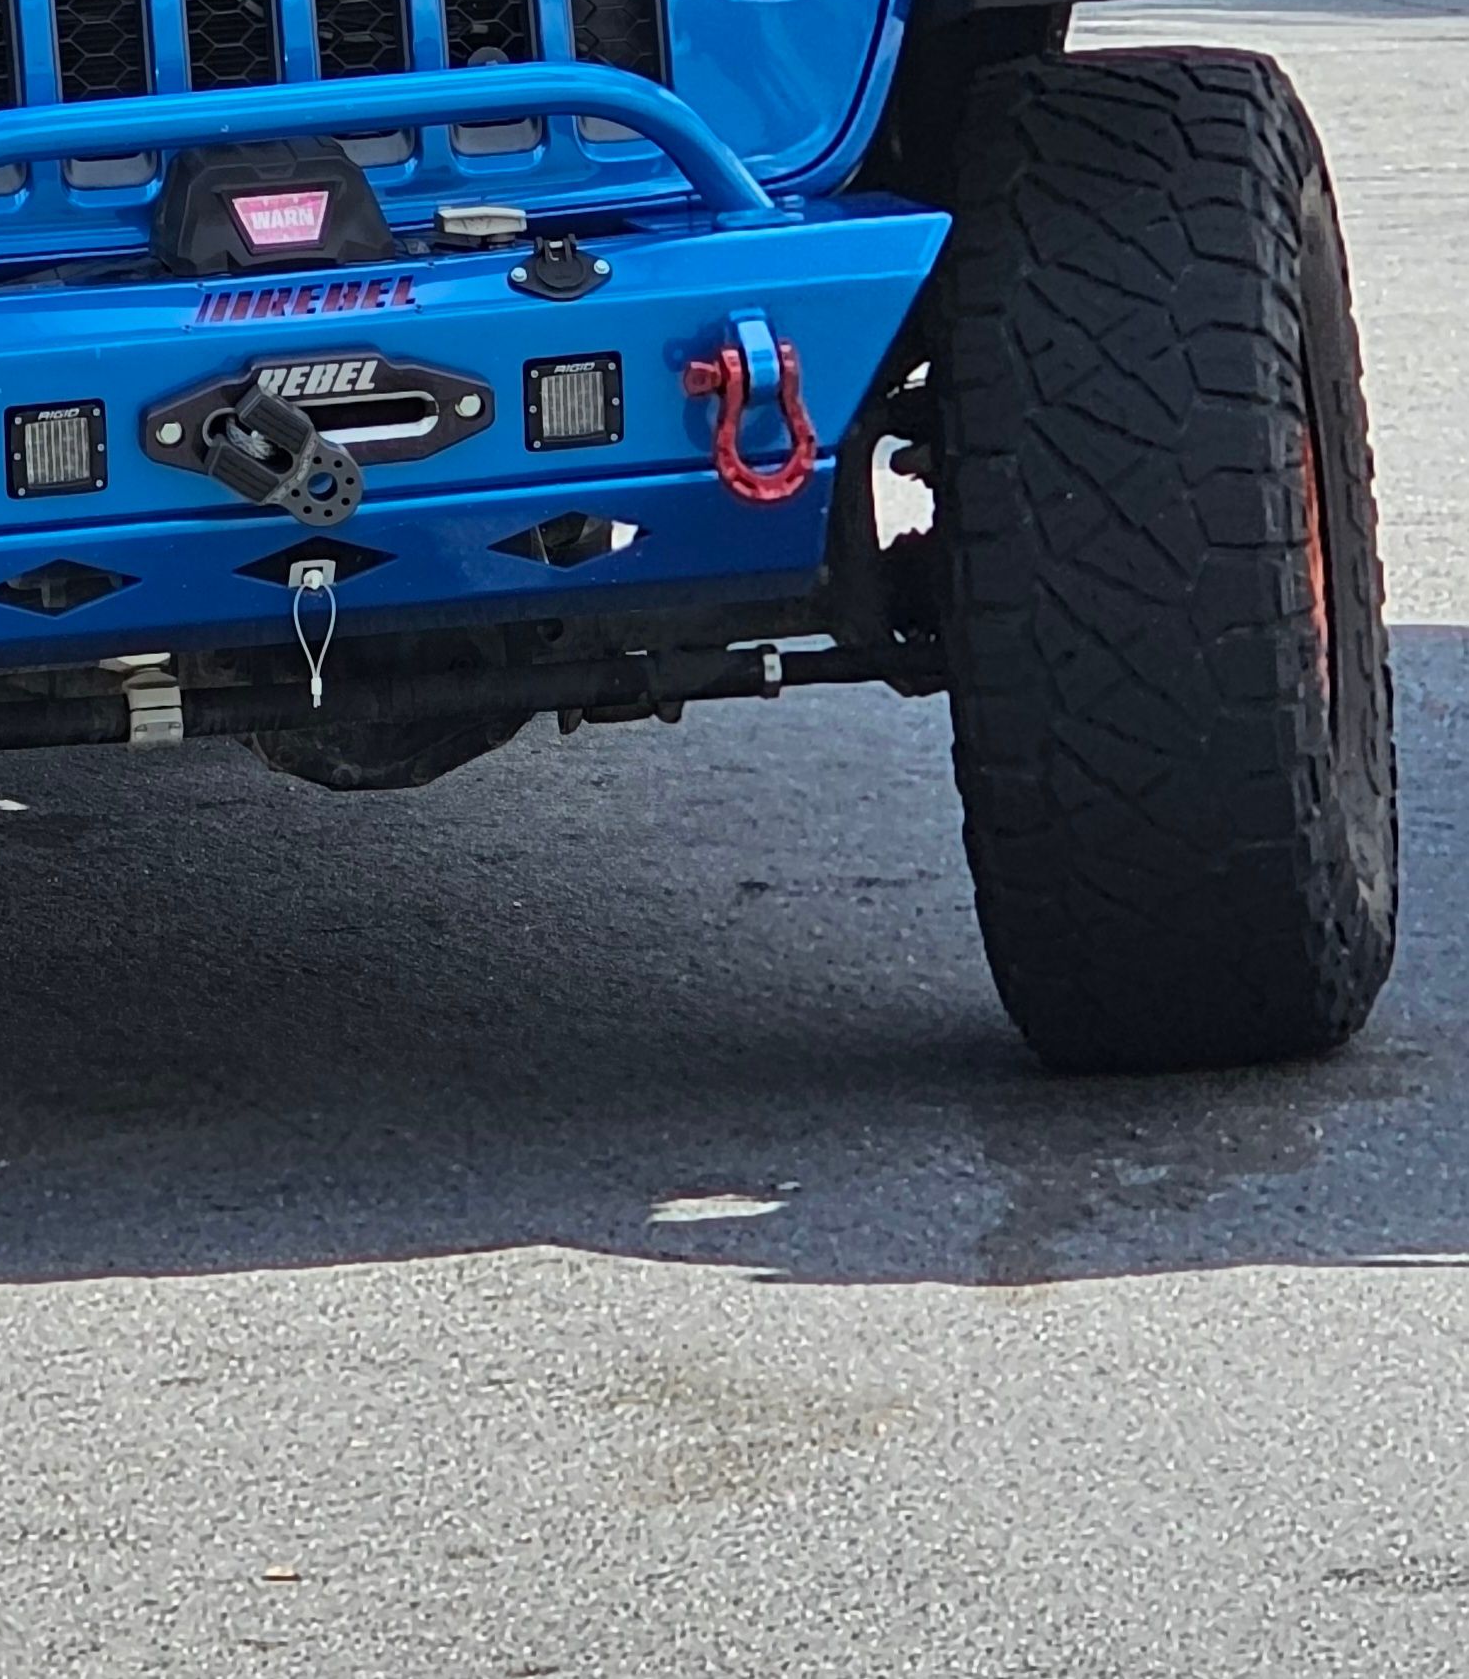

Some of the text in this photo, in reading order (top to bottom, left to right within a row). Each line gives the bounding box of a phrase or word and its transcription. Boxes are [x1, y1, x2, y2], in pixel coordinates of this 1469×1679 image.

[251, 207, 314, 230] WARN
[554, 361, 596, 374] RIGID
[256, 360, 379, 398] REBEL
[37, 408, 80, 421] RIGID
